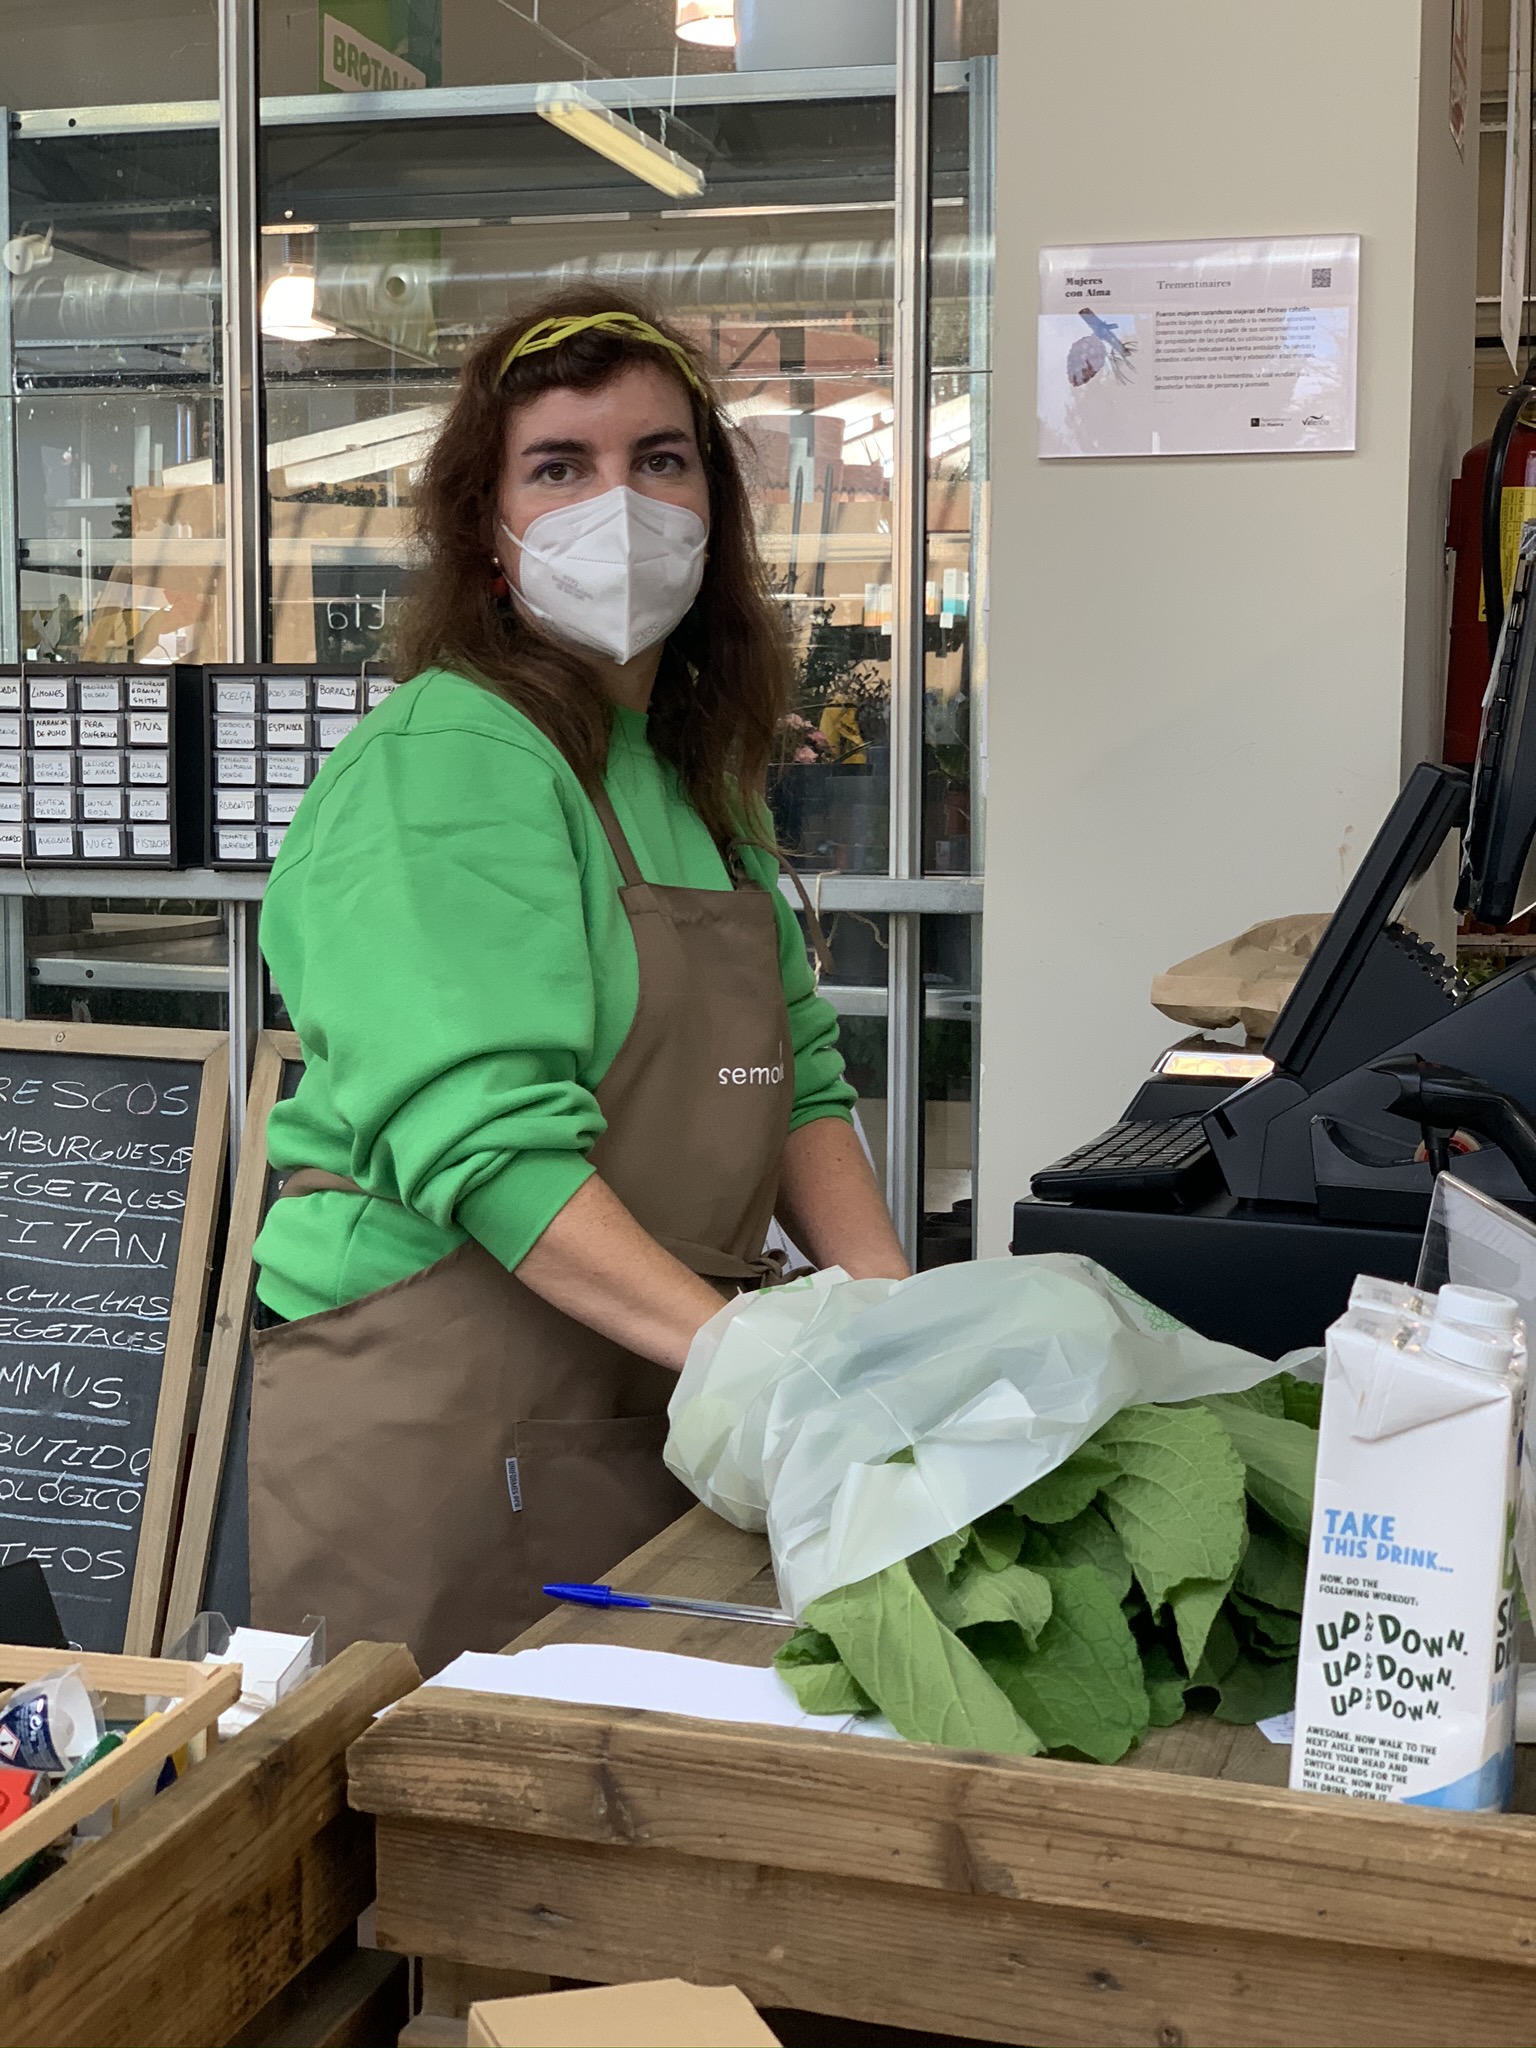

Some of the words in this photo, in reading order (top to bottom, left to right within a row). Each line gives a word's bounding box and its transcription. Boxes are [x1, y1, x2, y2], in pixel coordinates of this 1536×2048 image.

[1065, 277, 1103, 286] Mujeres
[1157, 280, 1232, 290] Trementinaires
[1065, 290, 1083, 298] con
[1086, 288, 1111, 298] Alma
[31, 687, 65, 698] LIMONES
[219, 691, 252, 704] ACELGA
[319, 684, 356, 697] BORRAJA
[368, 685, 400, 694] CALABA
[36, 719, 69, 727] NARANJA
[84, 719, 104, 728] PERA
[133, 718, 163, 731] PIÑA
[85, 838, 114, 848] NUEZ
[1324, 1508, 1396, 1542] TAKE
[1322, 1536, 1368, 1559] THIS
[1376, 1542, 1454, 1573] DRINK...
[1346, 1576, 1360, 1586] DO
[1362, 1578, 1379, 1589] THE
[1319, 1585, 1370, 1599] FOLLOWING
[1372, 1591, 1419, 1607] WORKOUT:
[1316, 1610, 1361, 1652] UP
[1364, 1611, 1374, 1642] AND
[1378, 1613, 1468, 1659] DOWN.
[1322, 1651, 1362, 1687] UP
[1364, 1651, 1373, 1679] AND
[1376, 1653, 1455, 1693] DOWN.
[1330, 1686, 1363, 1717] UP
[1364, 1687, 1372, 1711] AND
[1375, 1688, 1442, 1722] DOWN.
[1305, 1736, 1329, 1748] NEXT
[1330, 1741, 1355, 1753] AISLE
[1357, 1745, 1380, 1757] WITH
[1383, 1749, 1399, 1760] THE
[1402, 1753, 1430, 1765] DRINK
[1354, 1734, 1376, 1745] NOW
[1378, 1738, 1403, 1750] WALK
[1406, 1742, 1418, 1752] TO
[1420, 1744, 1438, 1755] THE
[1304, 1747, 1333, 1760] ABOVE
[1335, 1753, 1359, 1765] YOUR
[1361, 1757, 1386, 1769] HEAD
[1388, 1762, 1408, 1773] AND
[1303, 1758, 1336, 1771] SWITCH
[1338, 1763, 1369, 1777] HANDS
[1371, 1770, 1388, 1781] FOR
[1391, 1773, 1408, 1785] THE
[1303, 1769, 1321, 1780] WAY
[1351, 1777, 1372, 1789] NOW
[1375, 1783, 1393, 1793] BUY
[1302, 1779, 1317, 1790] THE
[1352, 1789, 1376, 1801] OPEN
[1378, 1794, 1388, 1802] IT
